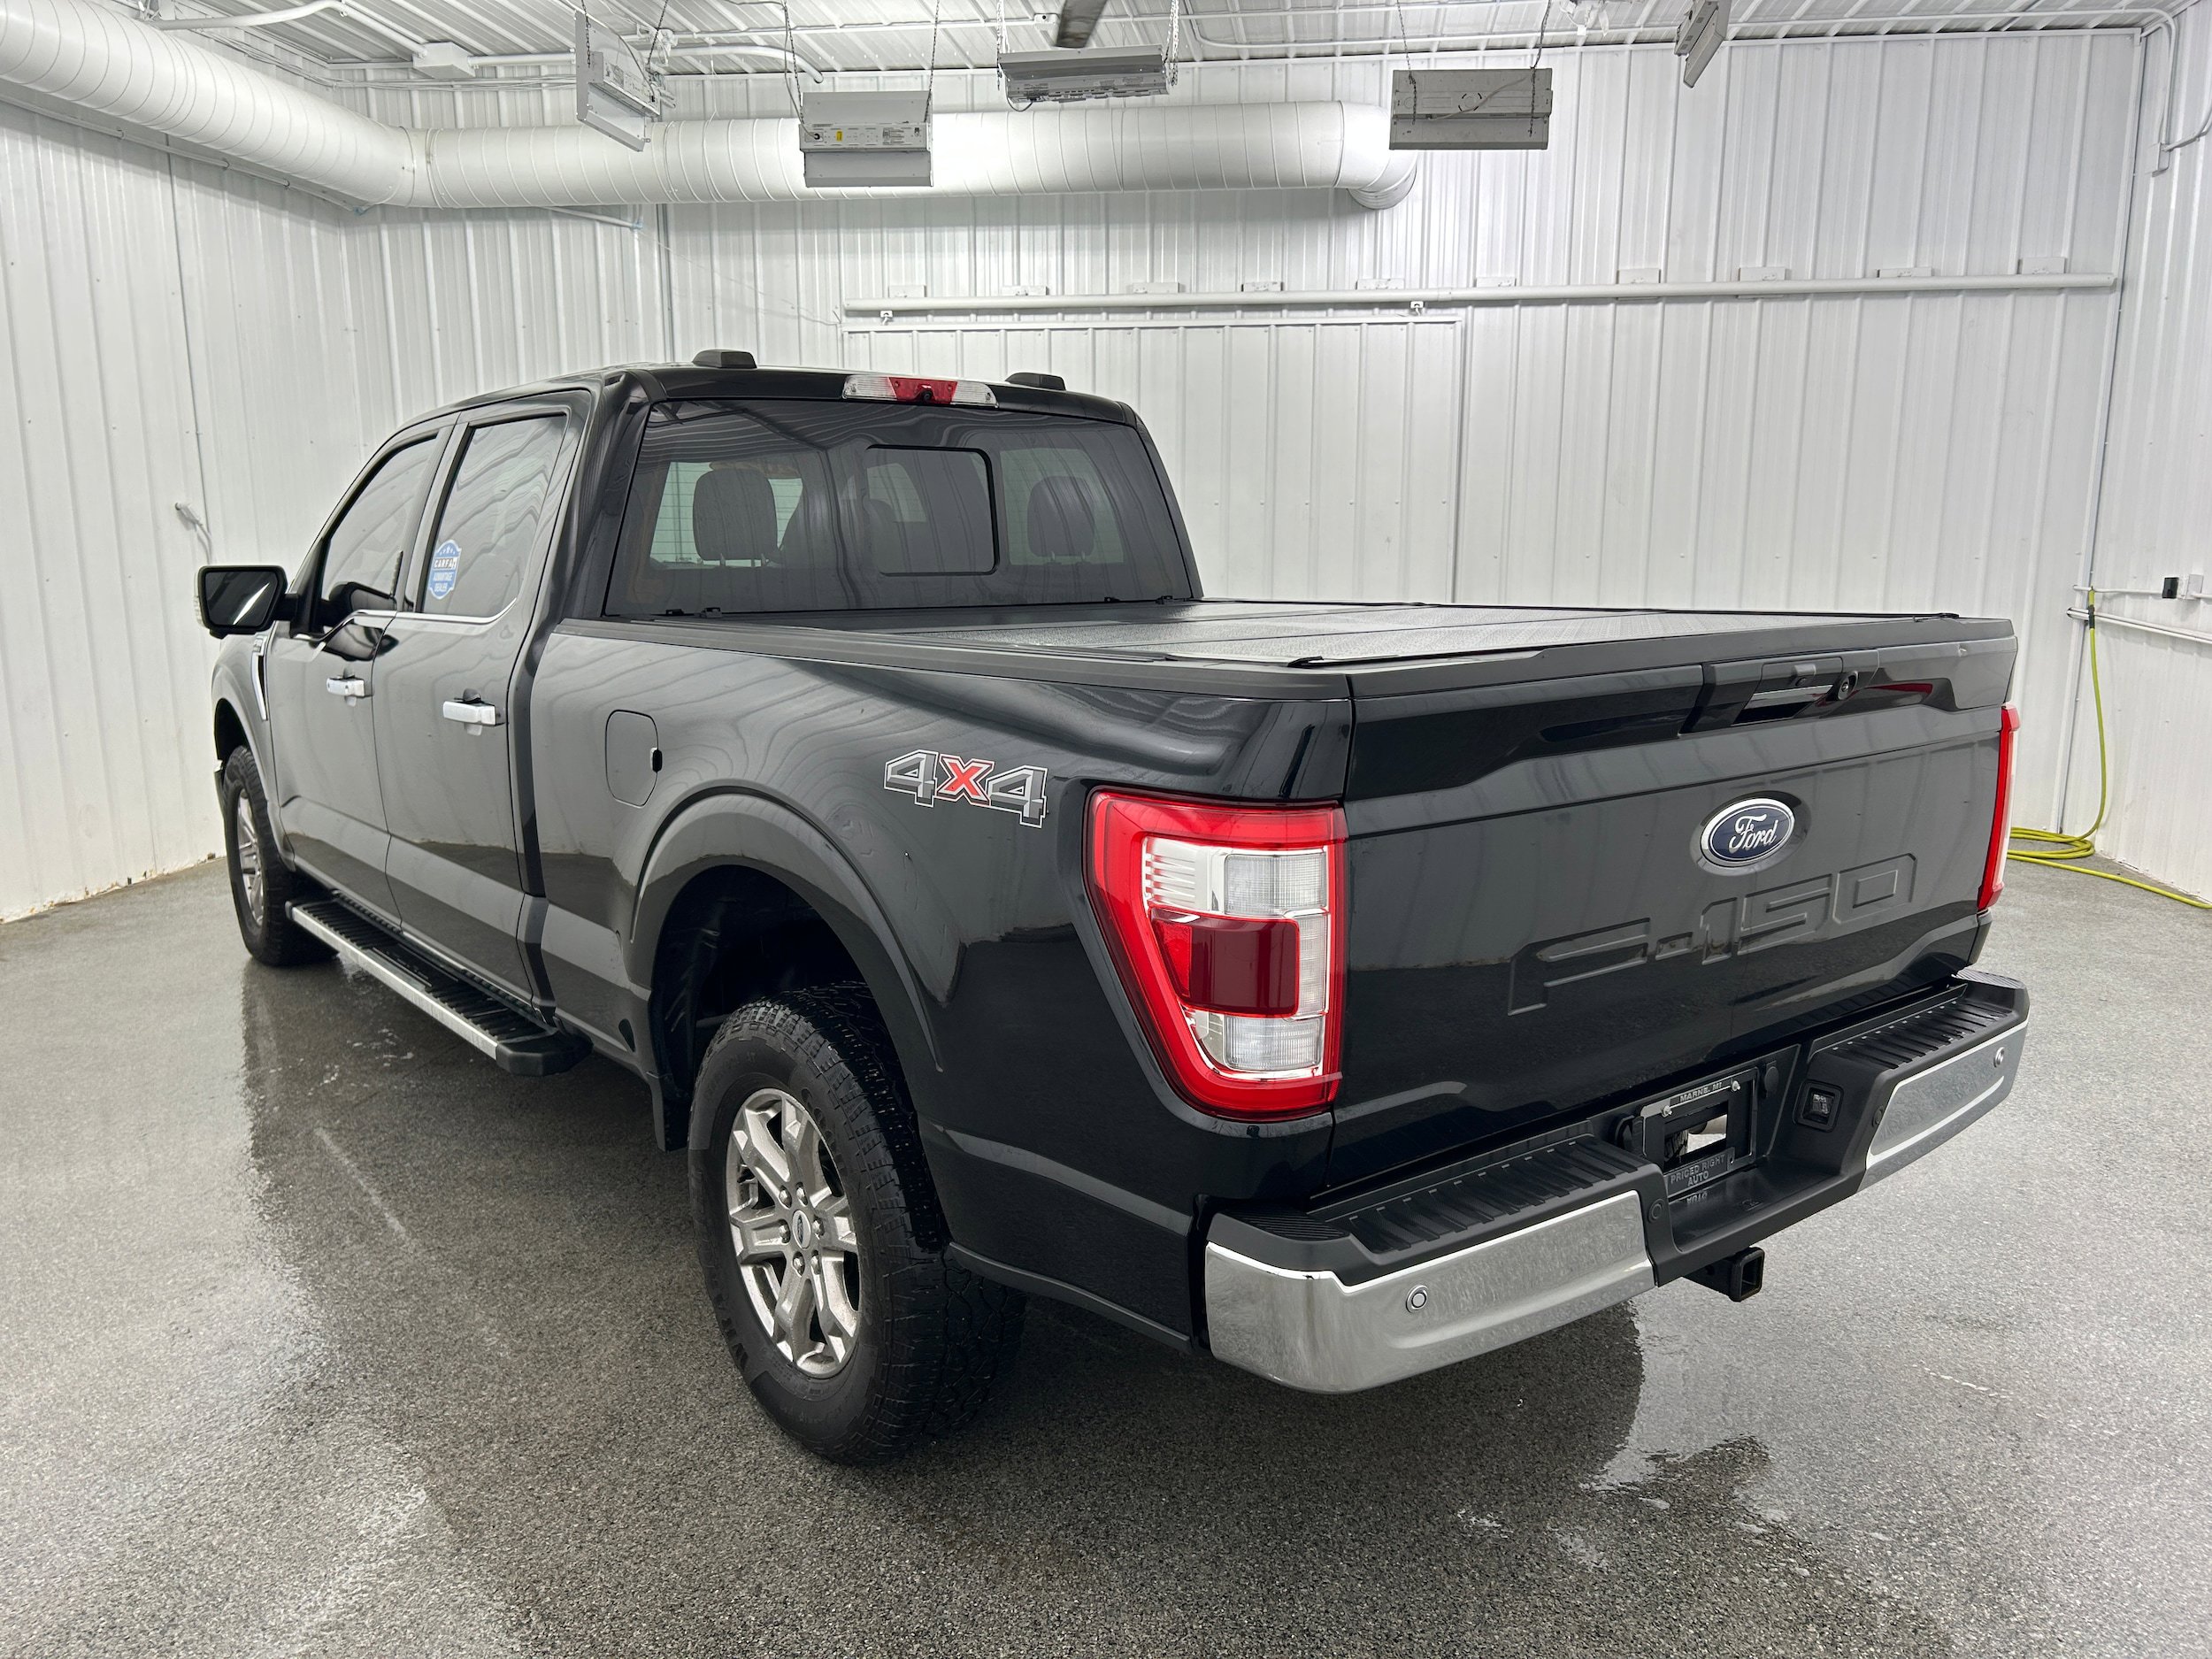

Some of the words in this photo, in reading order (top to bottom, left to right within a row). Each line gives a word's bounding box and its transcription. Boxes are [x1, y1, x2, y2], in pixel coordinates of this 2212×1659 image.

[1727, 813, 1780, 854] Ford
[1507, 850, 1918, 1017] F-150
[1712, 1081, 1723, 1093] MI
[1670, 1164, 1701, 1184] PRICED
[1701, 1154, 1725, 1171] RIGHT
[1687, 1171, 1709, 1187] AUTO
